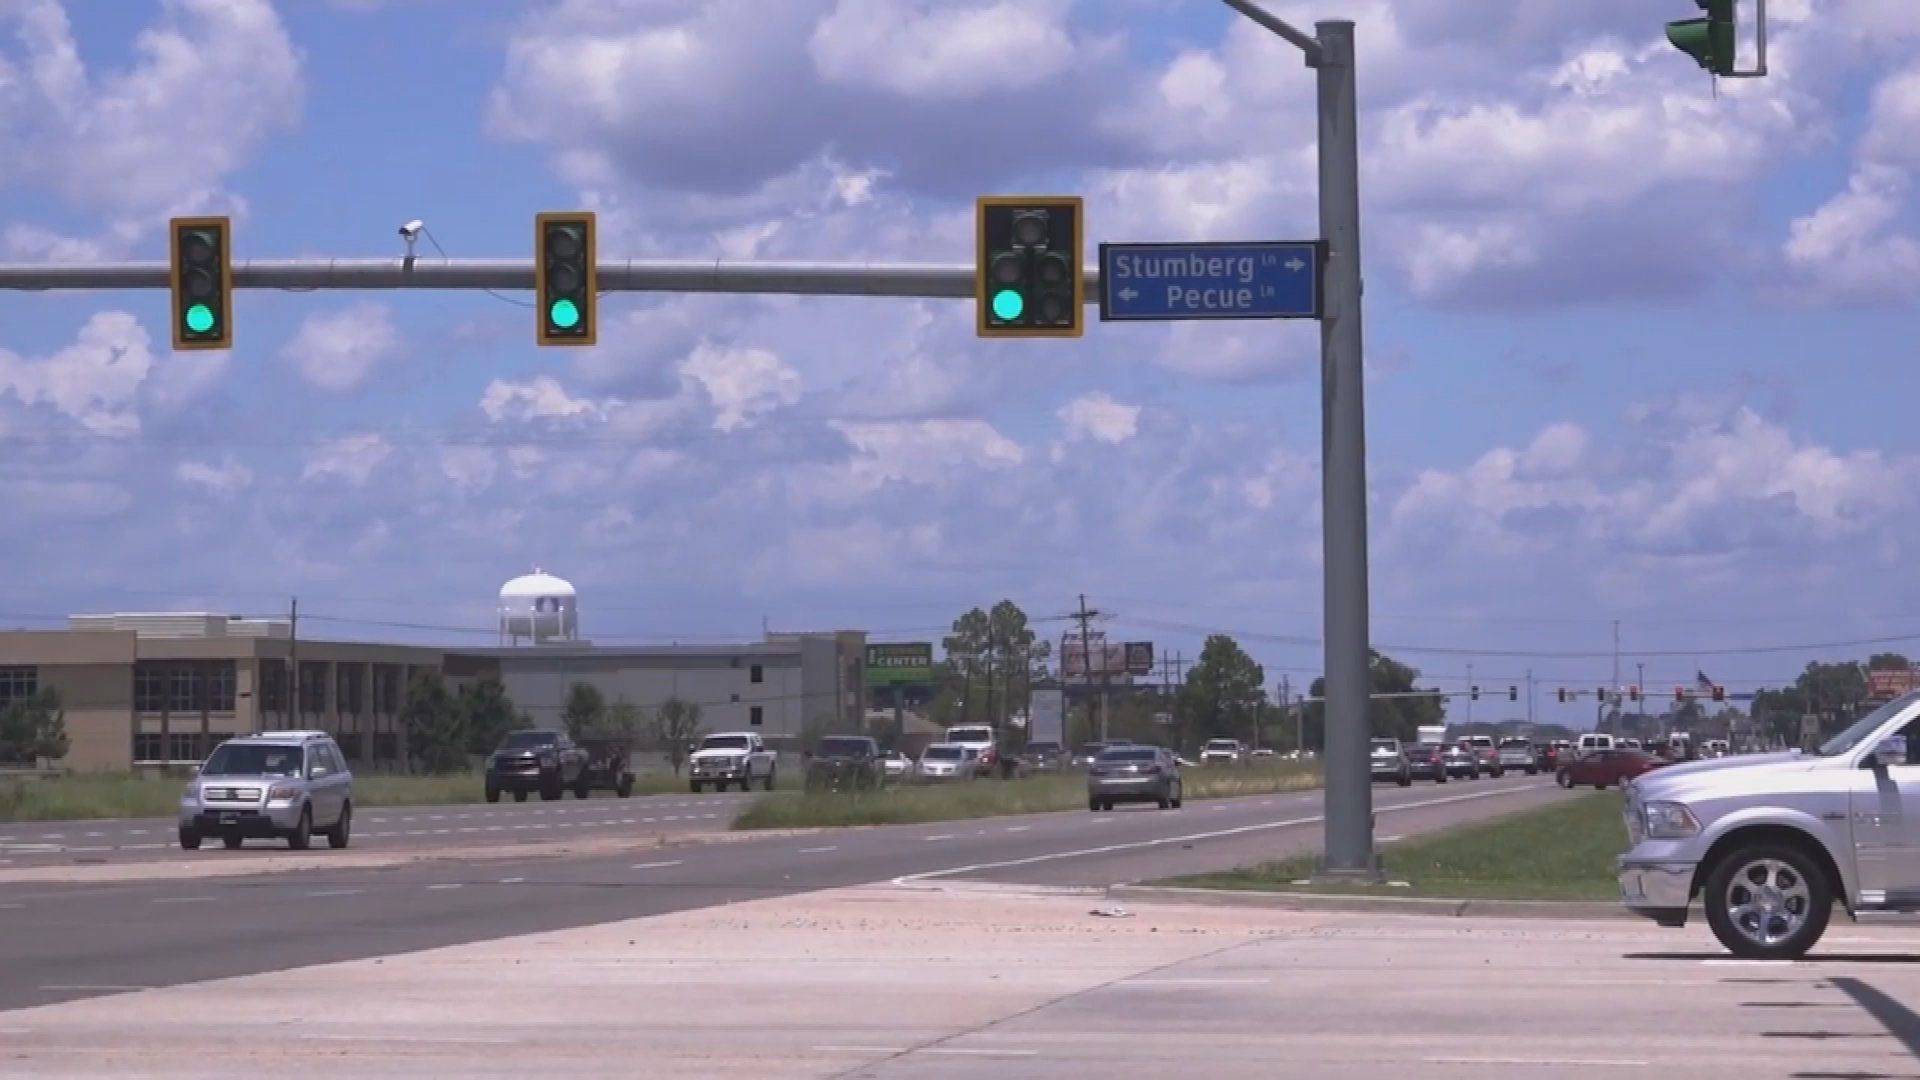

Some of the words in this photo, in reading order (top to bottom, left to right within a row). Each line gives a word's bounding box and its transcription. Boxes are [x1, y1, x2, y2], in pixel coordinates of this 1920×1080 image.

[1116, 254, 1254, 283] Stumberg
[1261, 253, 1277, 265] Ln
[1167, 285, 1252, 308] Pecue
[1260, 285, 1275, 297] Ln
[876, 655, 928, 667] CENTER
